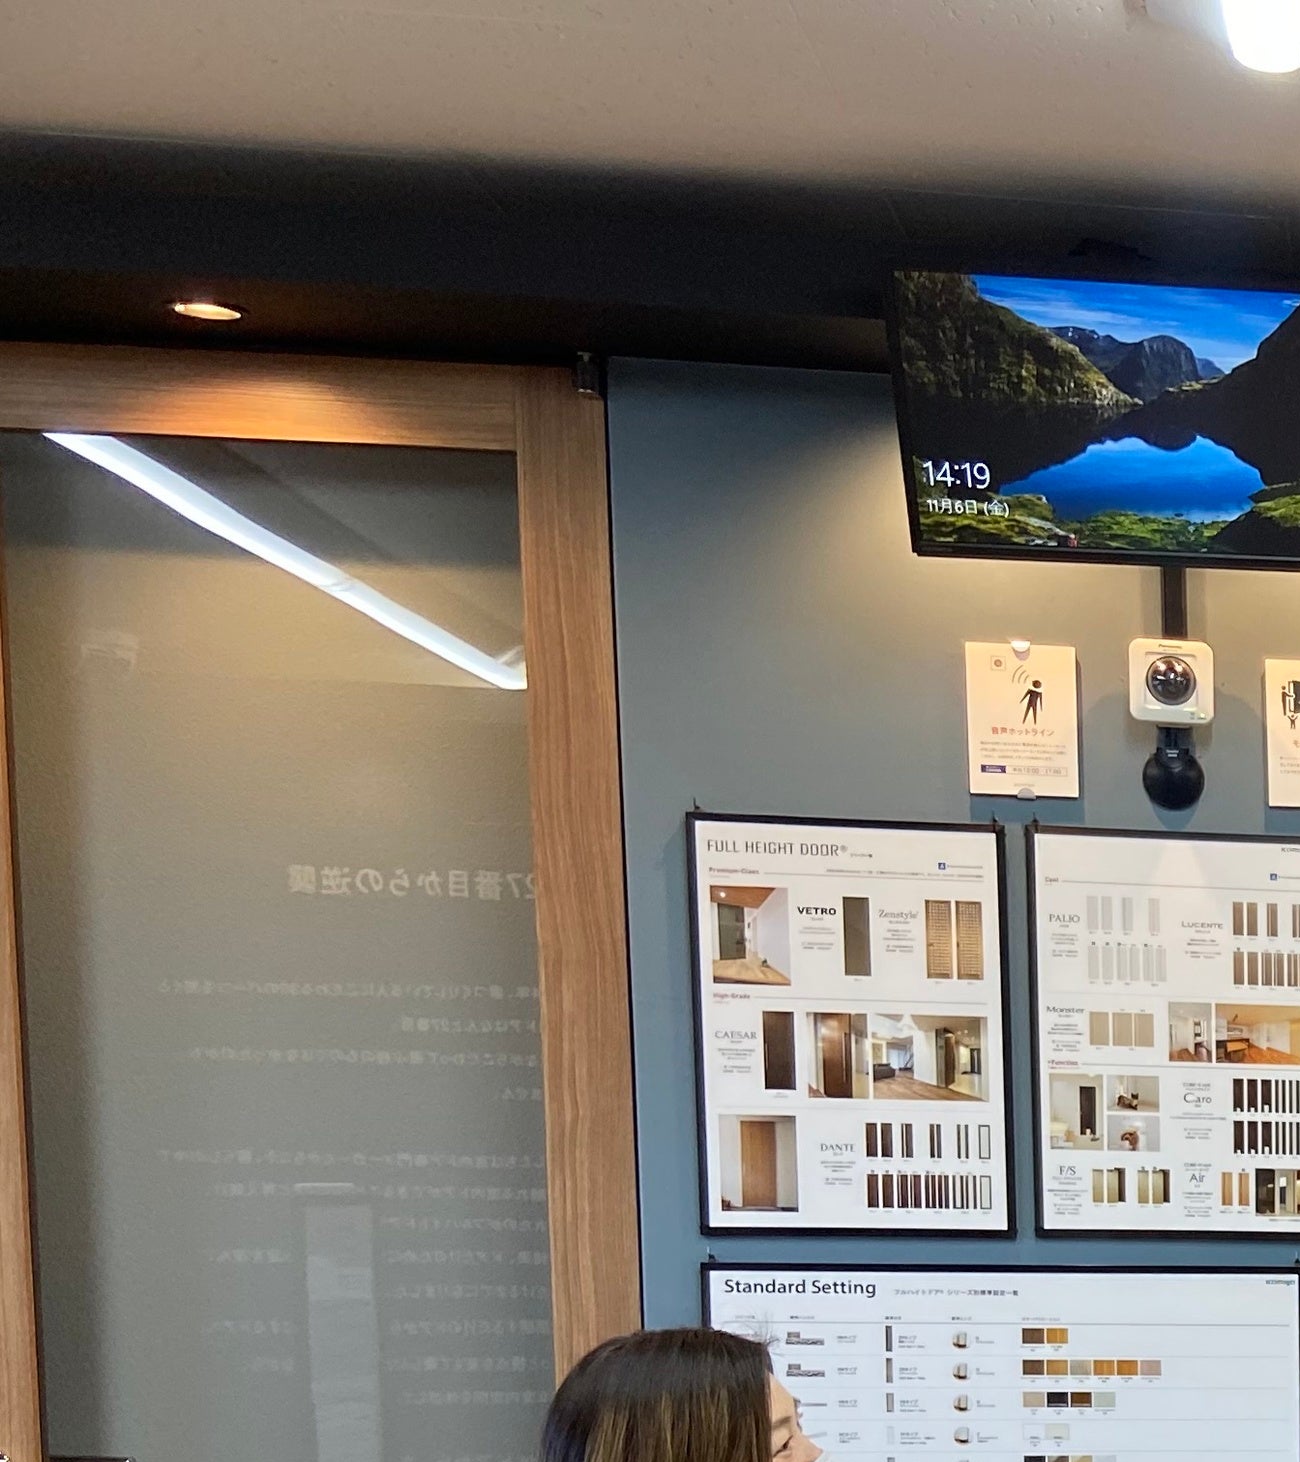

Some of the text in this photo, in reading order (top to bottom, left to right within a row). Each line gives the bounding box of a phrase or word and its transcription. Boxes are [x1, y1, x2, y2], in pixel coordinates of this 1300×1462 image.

[922, 460, 991, 489] 14:19
[926, 498, 1010, 518] 11月6日 (金)
[991, 726, 1055, 737] 音声ホットライン
[707, 839, 740, 853] FULL
[745, 840, 794, 855] HEIGHT
[797, 906, 837, 916] VETRO
[1049, 913, 1081, 923] PALIO
[1183, 1092, 1212, 1104] Caro
[820, 1142, 856, 1152] DANTE
[1059, 1165, 1077, 1176] F/S
[724, 1279, 807, 1294] Standard
[812, 1280, 877, 1299] Setting
